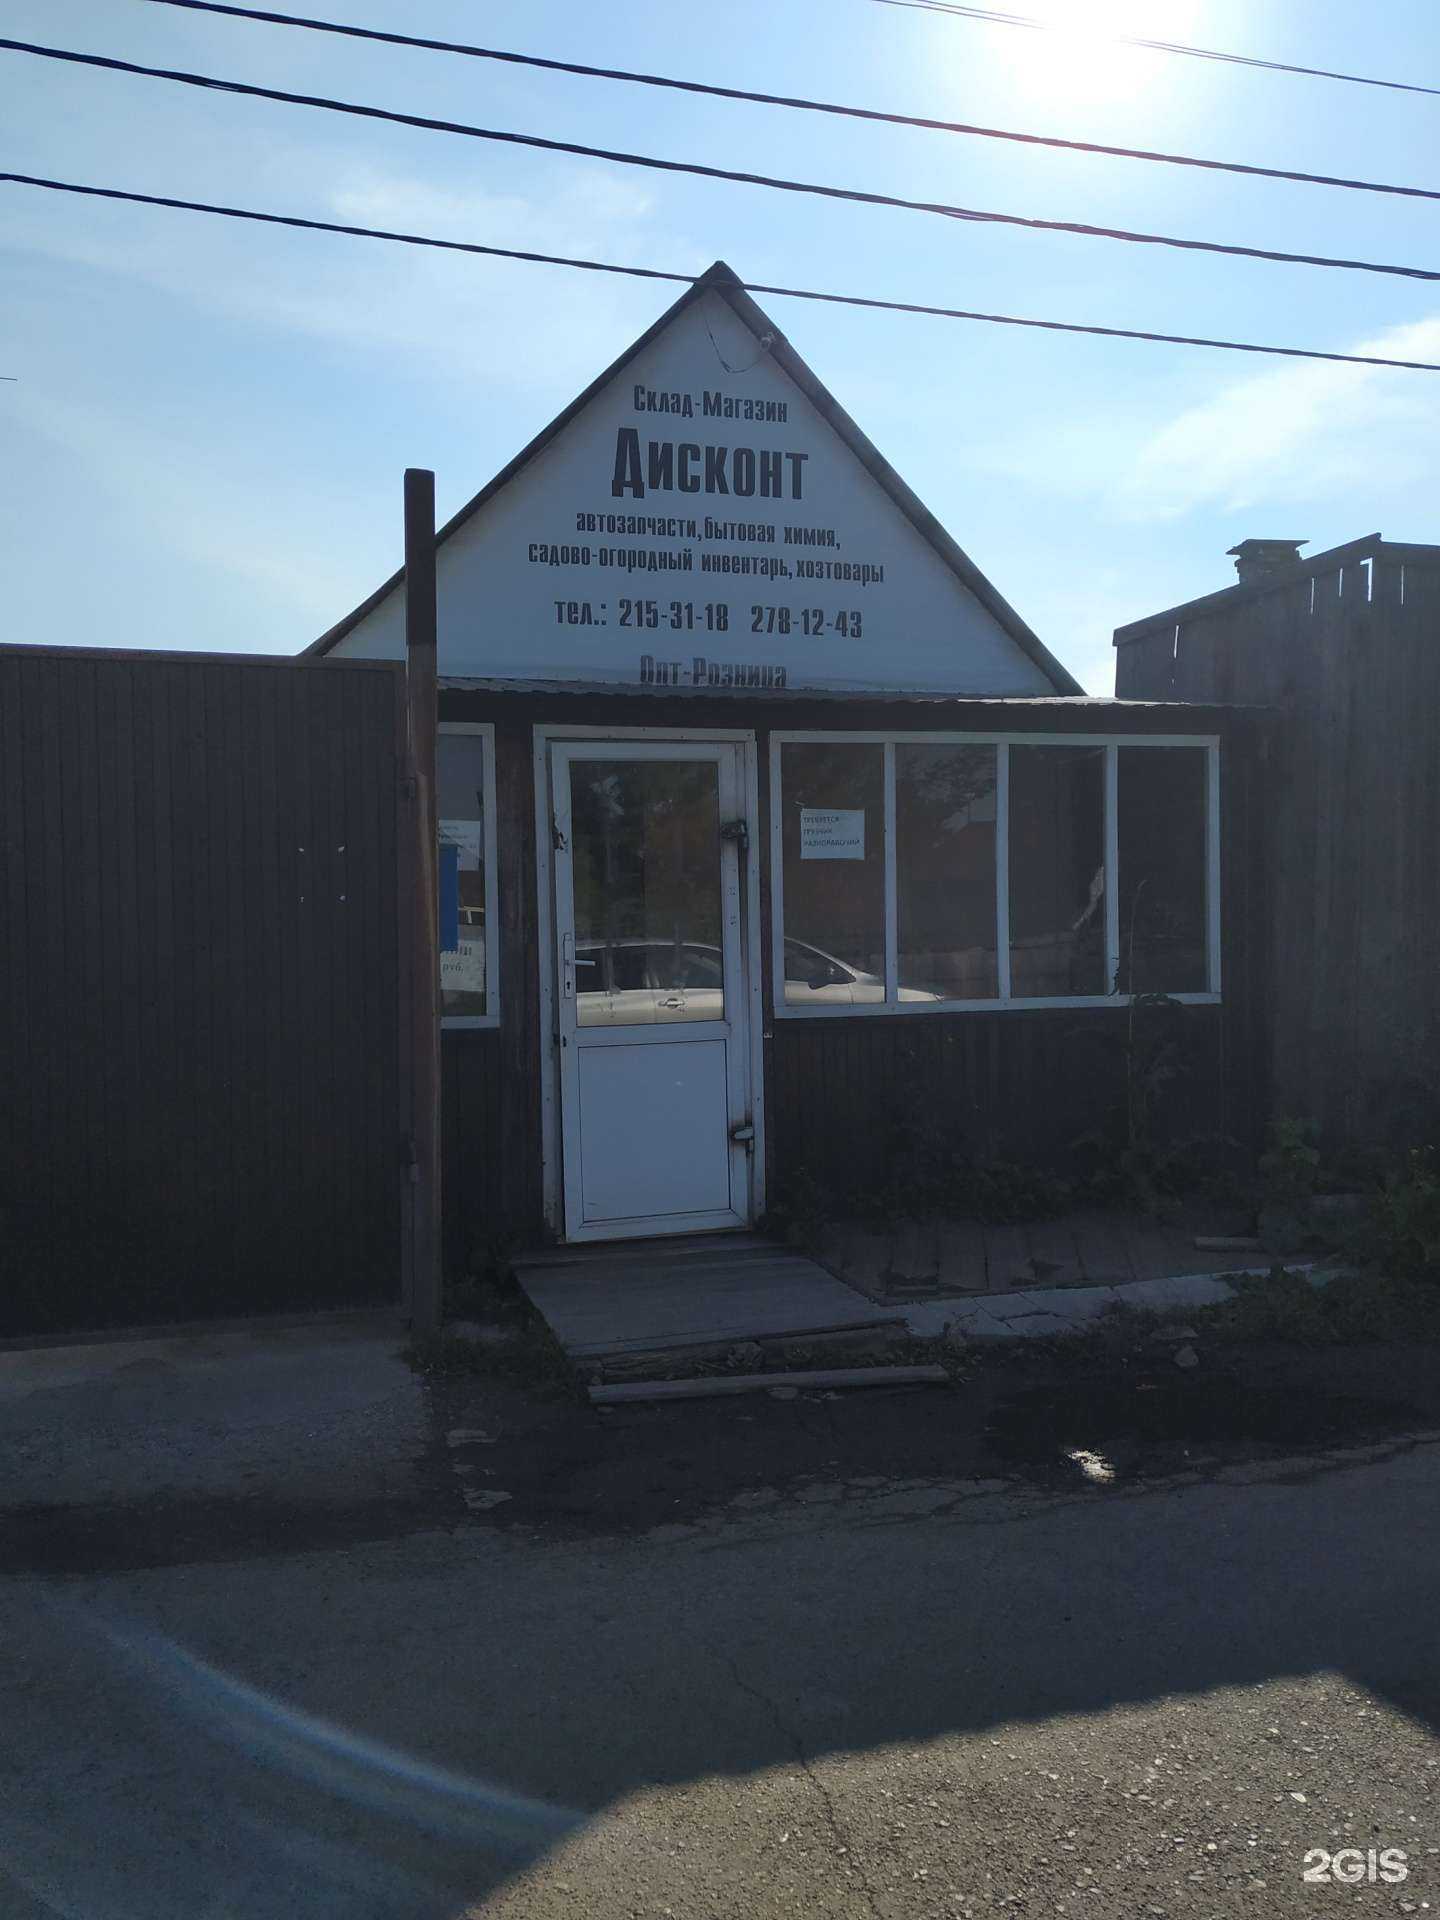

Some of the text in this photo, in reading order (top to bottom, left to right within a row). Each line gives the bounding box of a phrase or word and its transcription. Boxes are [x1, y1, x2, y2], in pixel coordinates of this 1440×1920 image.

[633, 384, 788, 423] Склад-Магазин
[611, 427, 809, 500] Дисконт
[783, 526, 841, 550] химия,
[528, 543, 693, 573] садово-огородный
[554, 599, 862, 639] тел.: 215-31-18 278-12-43
[640, 655, 787, 688] Опт-Розница
